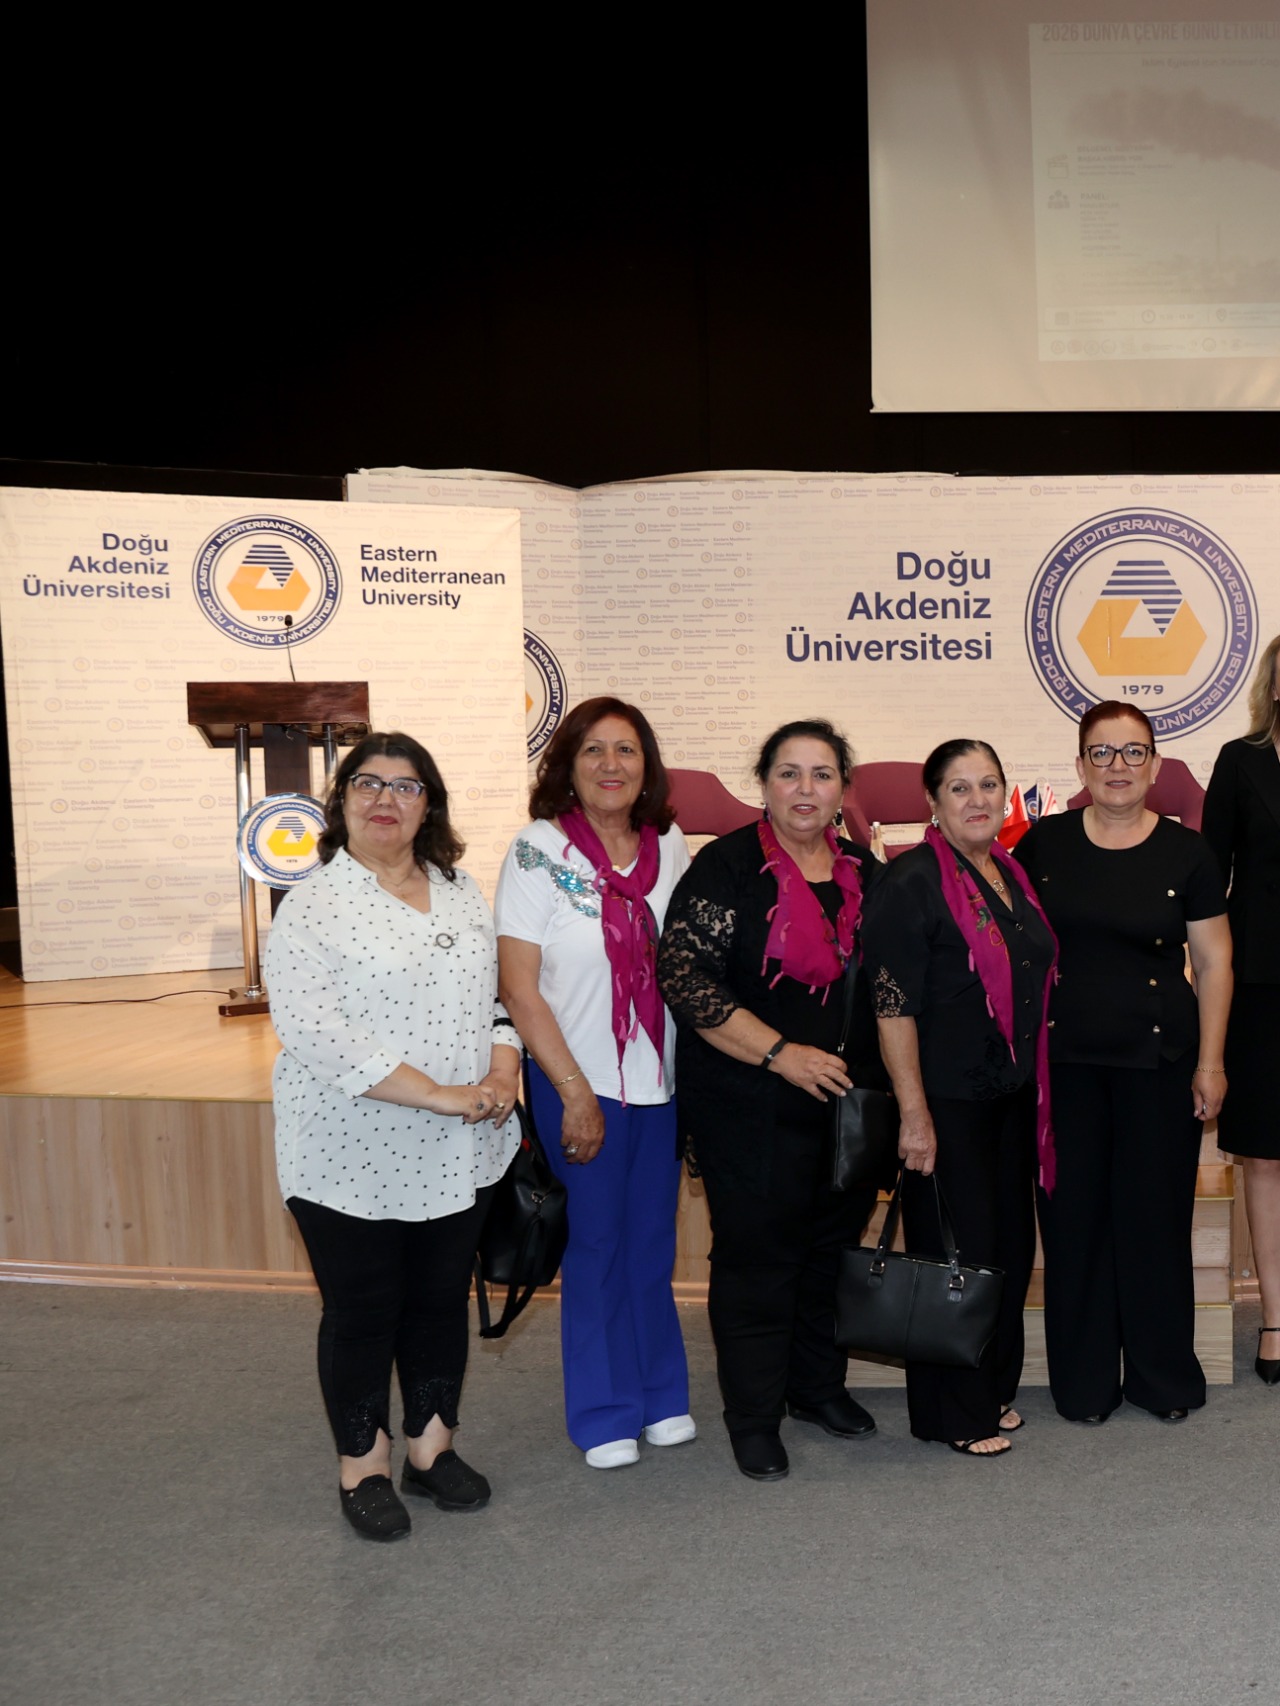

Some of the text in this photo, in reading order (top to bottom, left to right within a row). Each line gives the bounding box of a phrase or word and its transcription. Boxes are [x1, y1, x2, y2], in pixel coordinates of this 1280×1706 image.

[1042, 23, 1079, 41] 2026
[102, 533, 169, 556] Doğu
[199, 520, 337, 593] EASTERN MEDITERRANEAN UNIVERSITY
[360, 544, 437, 562] Eastern
[68, 555, 170, 575] Akdeniz
[361, 566, 506, 585] Mediterranean
[896, 550, 991, 587] Doğu
[23, 574, 171, 599] Üniversitesi
[1037, 518, 1249, 643] EASTERN MEDITERRANEAN UNIVERSITY
[362, 588, 461, 609] University
[847, 590, 992, 620] Akdeniz
[203, 596, 335, 644] DOĞU AKDENİZ ÜNİVERSİTESİ
[256, 615, 285, 623] 1979
[786, 626, 992, 662] Üniversitesi
[529, 643, 561, 706] UNIVERSITY
[1040, 651, 1245, 733] DOĞU ÜNİVERSİTESİ
[1121, 684, 1164, 695] 1979
